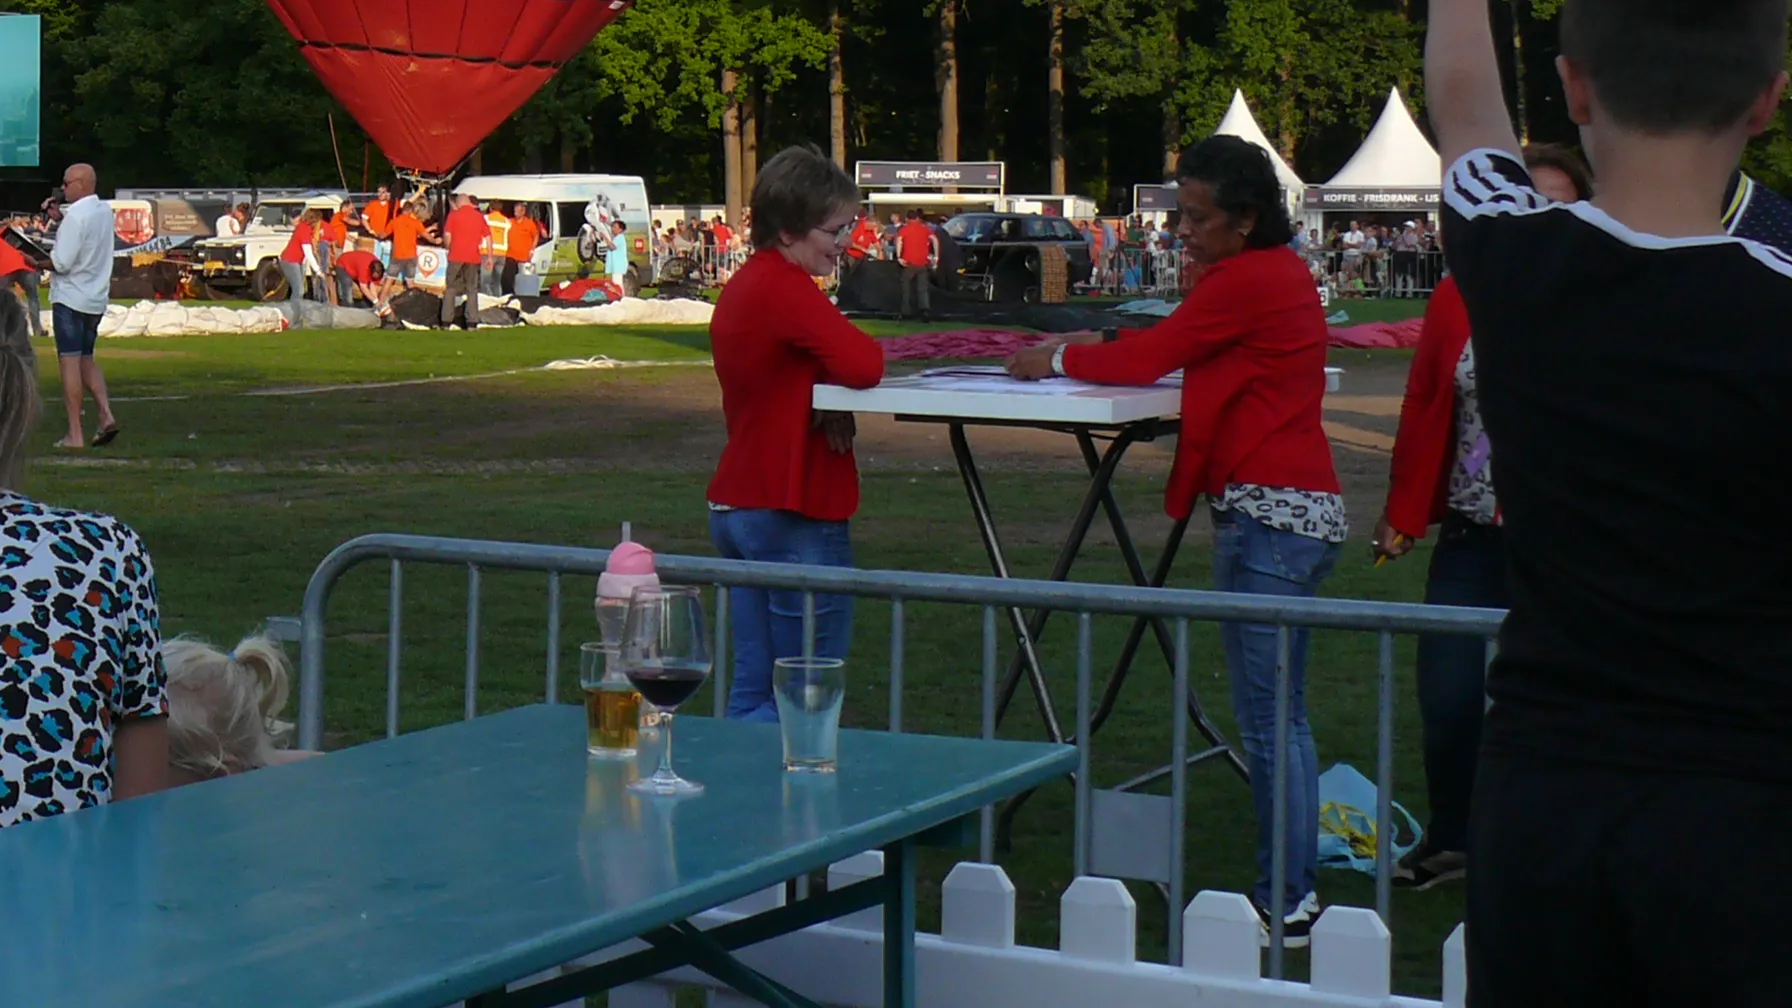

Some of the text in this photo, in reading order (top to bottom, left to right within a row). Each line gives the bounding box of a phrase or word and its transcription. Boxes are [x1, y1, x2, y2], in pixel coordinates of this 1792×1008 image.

[895, 170, 920, 179] FRIET
[925, 170, 961, 180] SNACKS
[1323, 193, 1357, 202] KOFFIE
[1364, 193, 1418, 203] FRISDRANK
